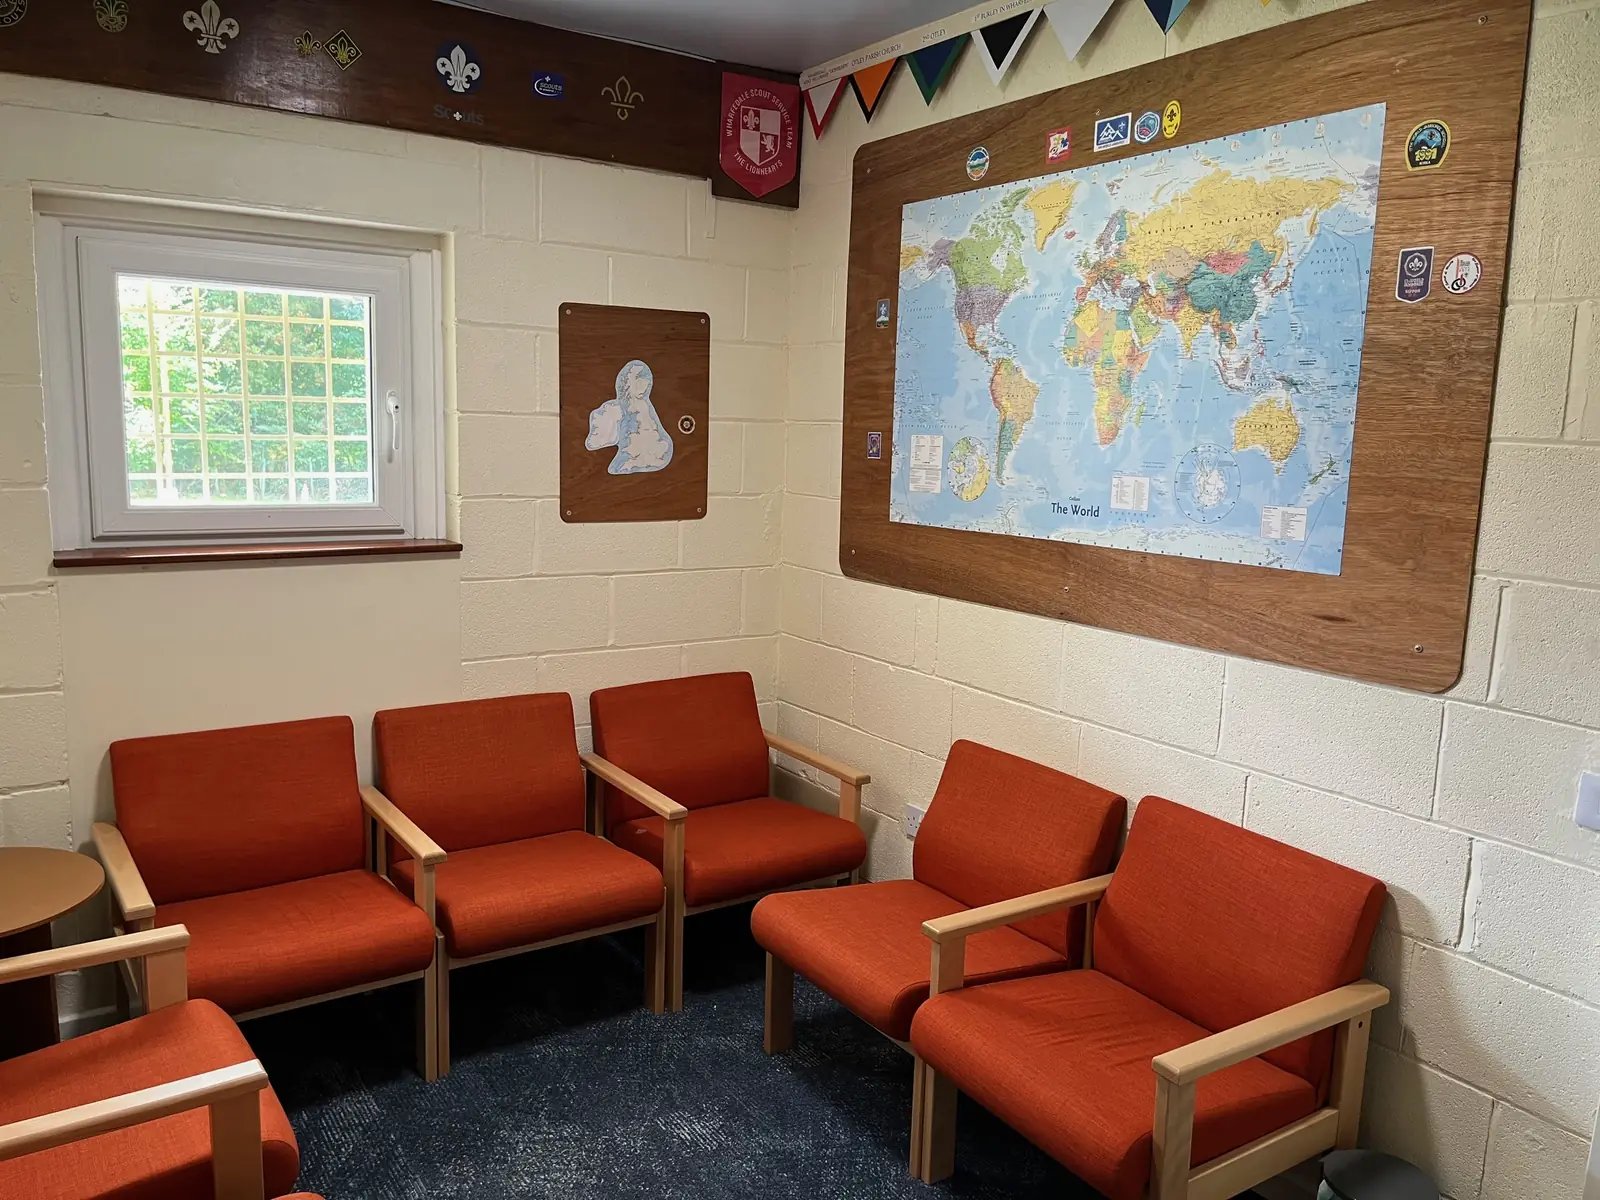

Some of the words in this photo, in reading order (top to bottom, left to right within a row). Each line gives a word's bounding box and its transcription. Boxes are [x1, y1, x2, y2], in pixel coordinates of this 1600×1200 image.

[0, 0, 26, 24] OUTS
[726, 89, 750, 137] WHARFEDALE
[750, 88, 771, 100] SCOUT
[771, 95, 792, 125] SERVICE
[785, 127, 794, 149] TEAM
[733, 151, 746, 167] THE
[745, 159, 783, 175] LIONHEARTS
[1051, 502, 1068, 514] The
[1070, 504, 1100, 518] World
